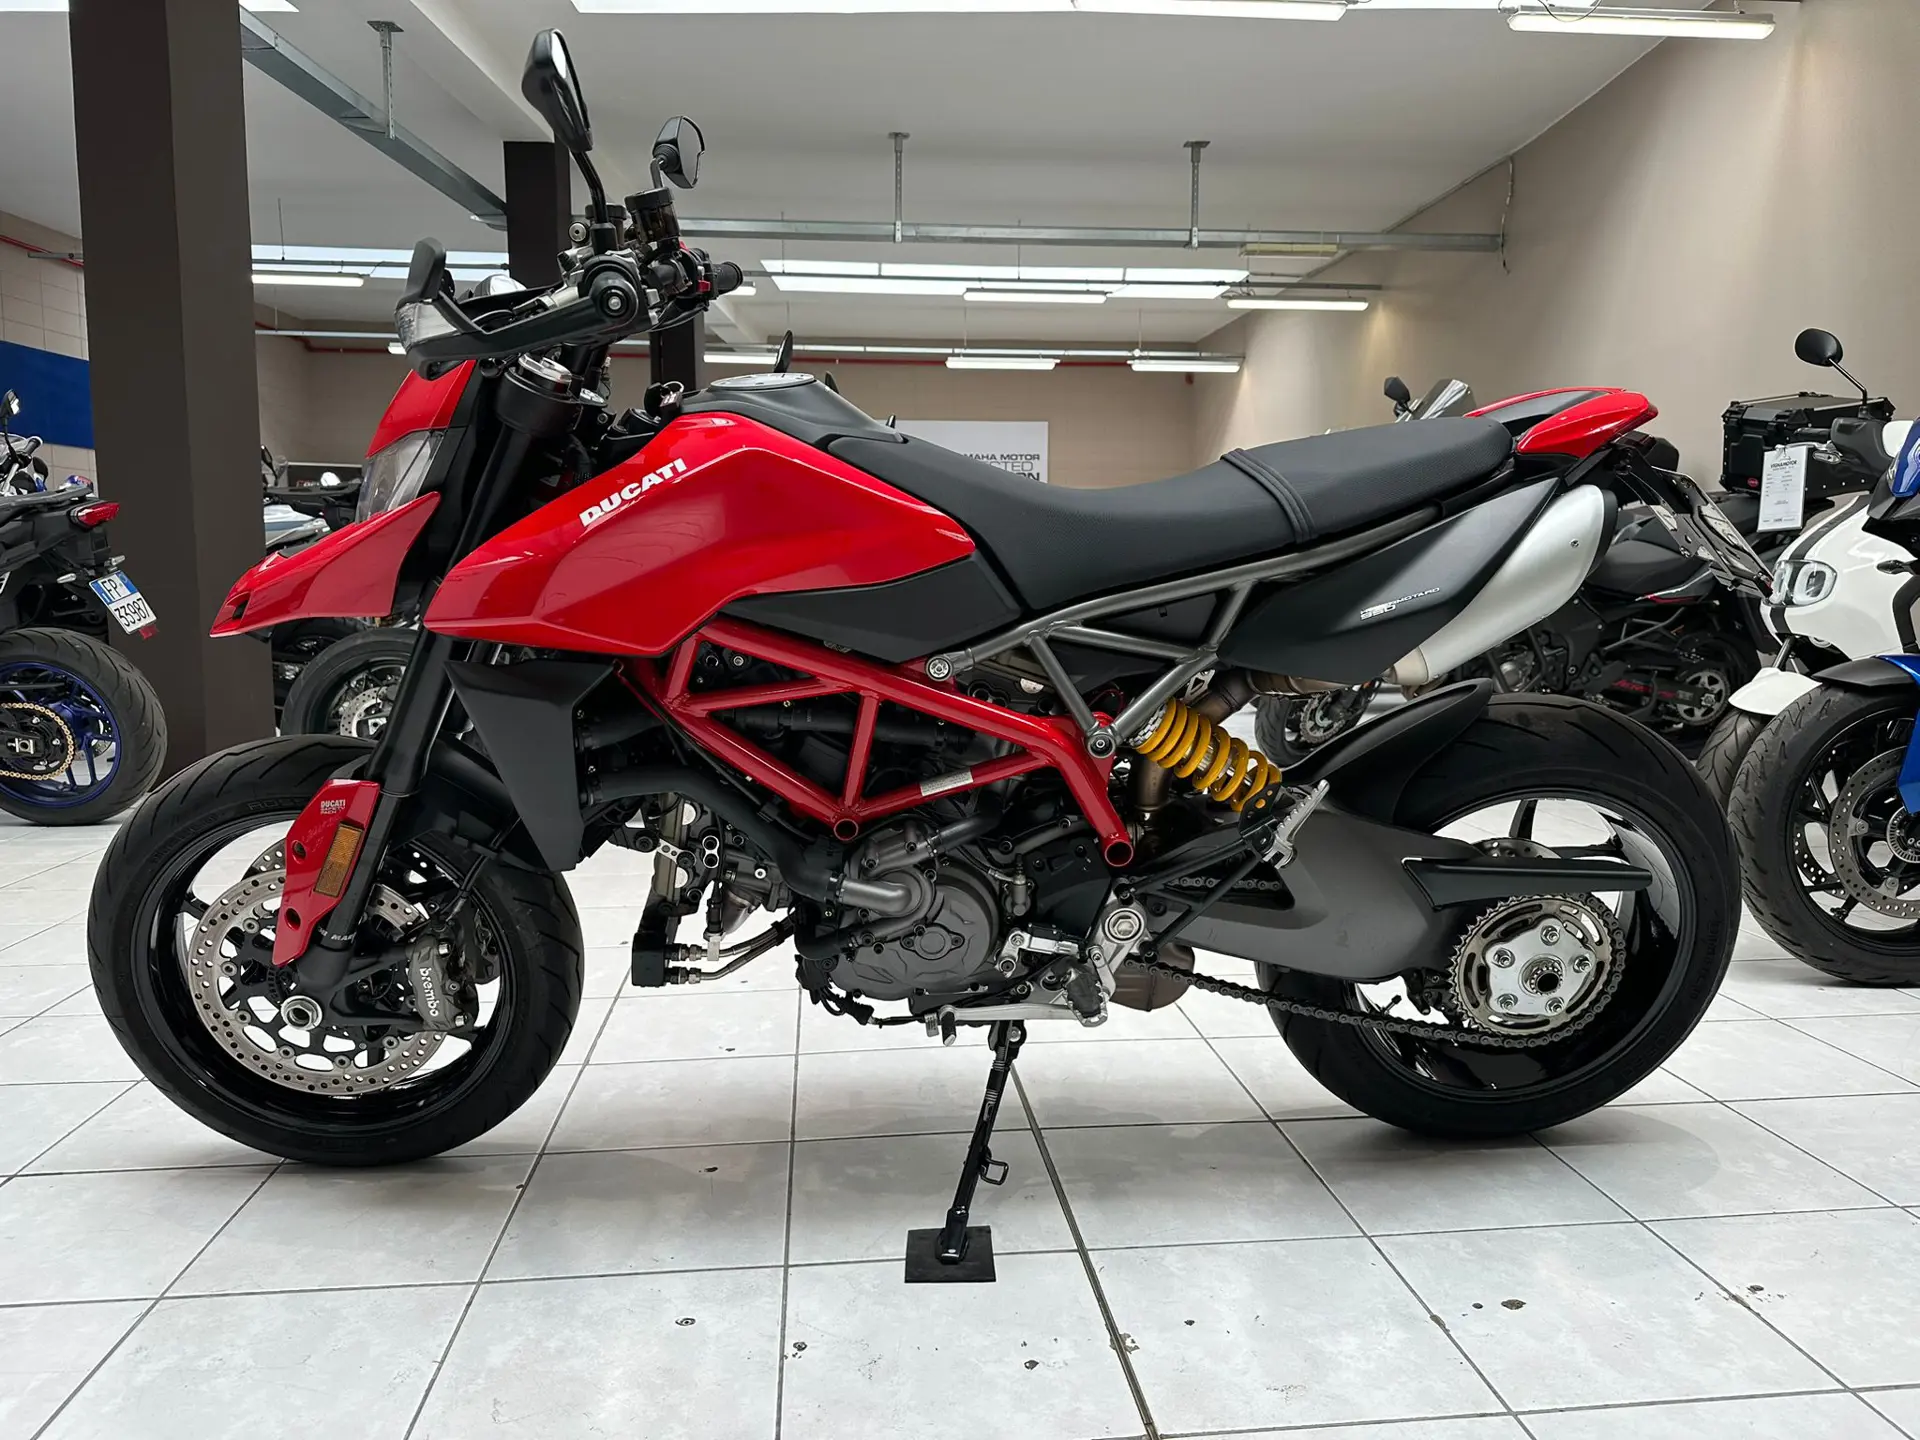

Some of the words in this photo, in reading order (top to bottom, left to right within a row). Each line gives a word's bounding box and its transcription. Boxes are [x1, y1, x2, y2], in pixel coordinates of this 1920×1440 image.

[1000, 453, 1040, 461] MOTOR
[579, 457, 687, 528] DUCATI
[101, 579, 121, 600] FP
[114, 598, 149, 626] 33987
[320, 799, 346, 808] DUCATI
[419, 967, 440, 1016] brembo
